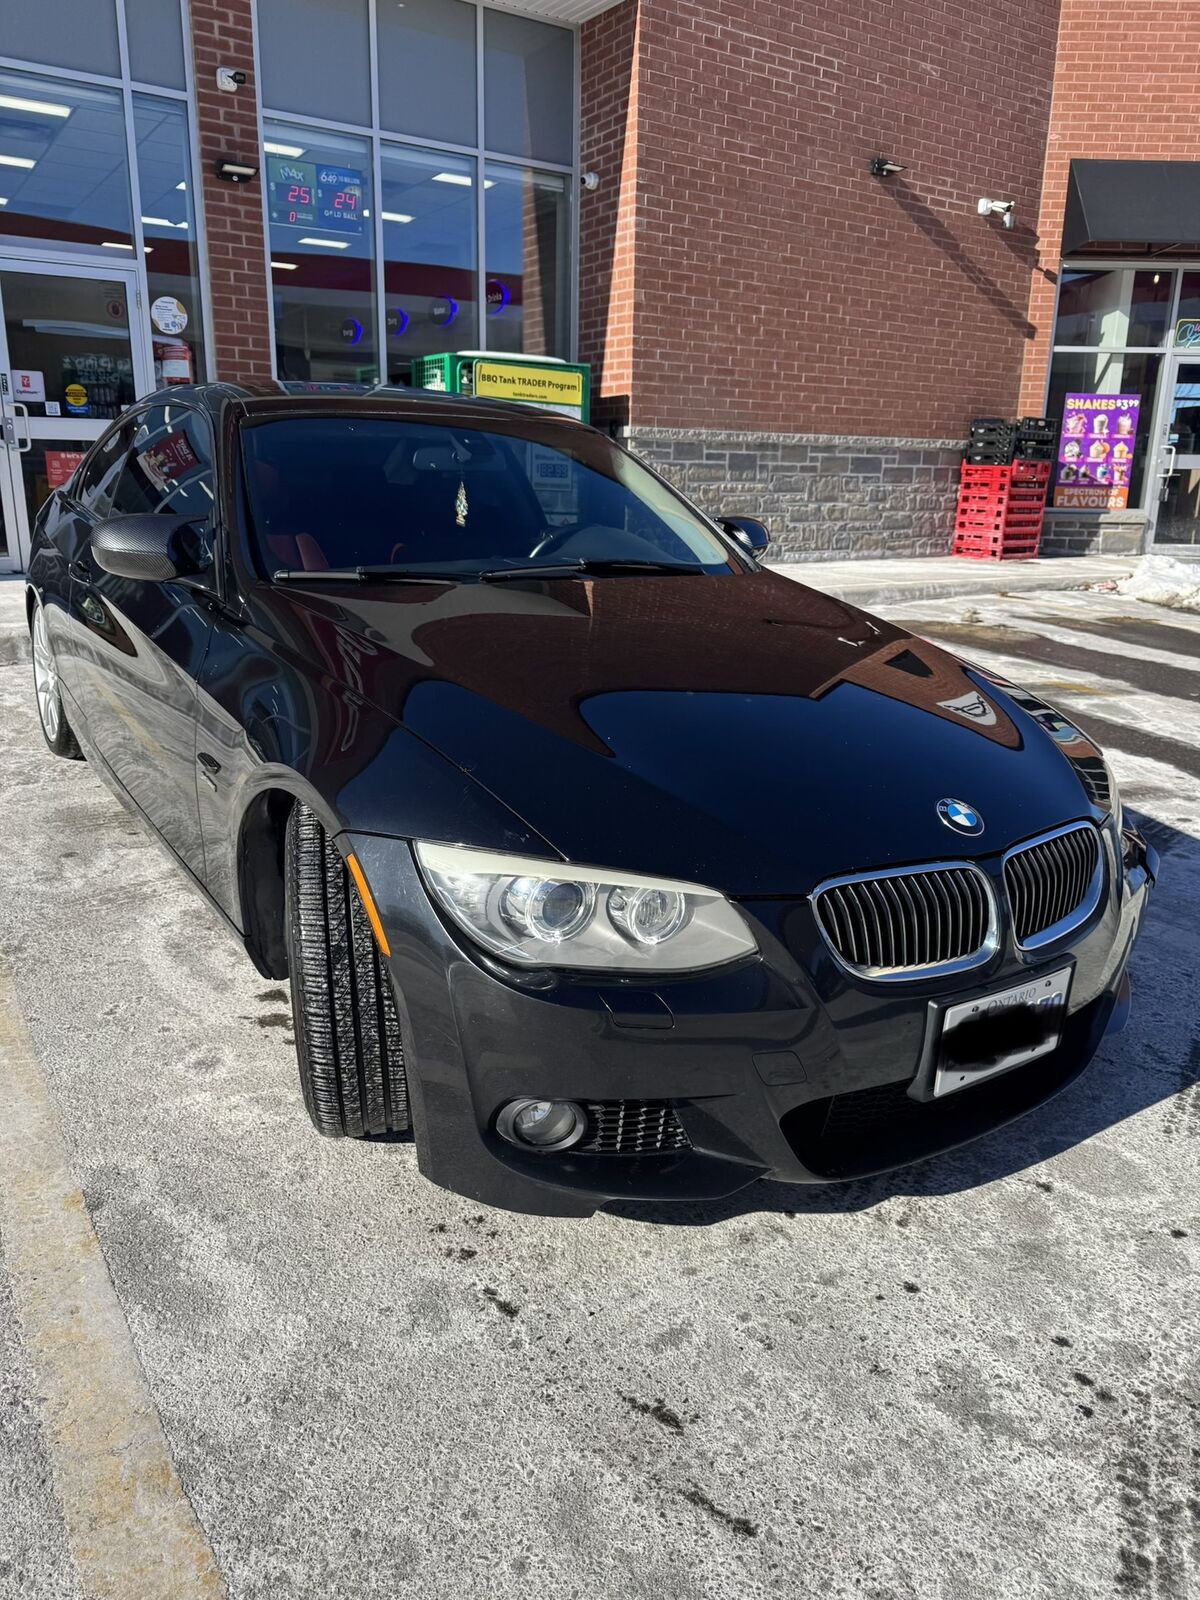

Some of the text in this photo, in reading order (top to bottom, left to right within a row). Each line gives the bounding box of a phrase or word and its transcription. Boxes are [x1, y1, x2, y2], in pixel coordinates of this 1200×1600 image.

[288, 184, 310, 204] 25
[334, 192, 356, 210] 24
[481, 373, 577, 392] BBQ Tank TRADER Program
[1066, 398, 1116, 411] SHAKES
[1056, 496, 1125, 509] FLAVOURS
